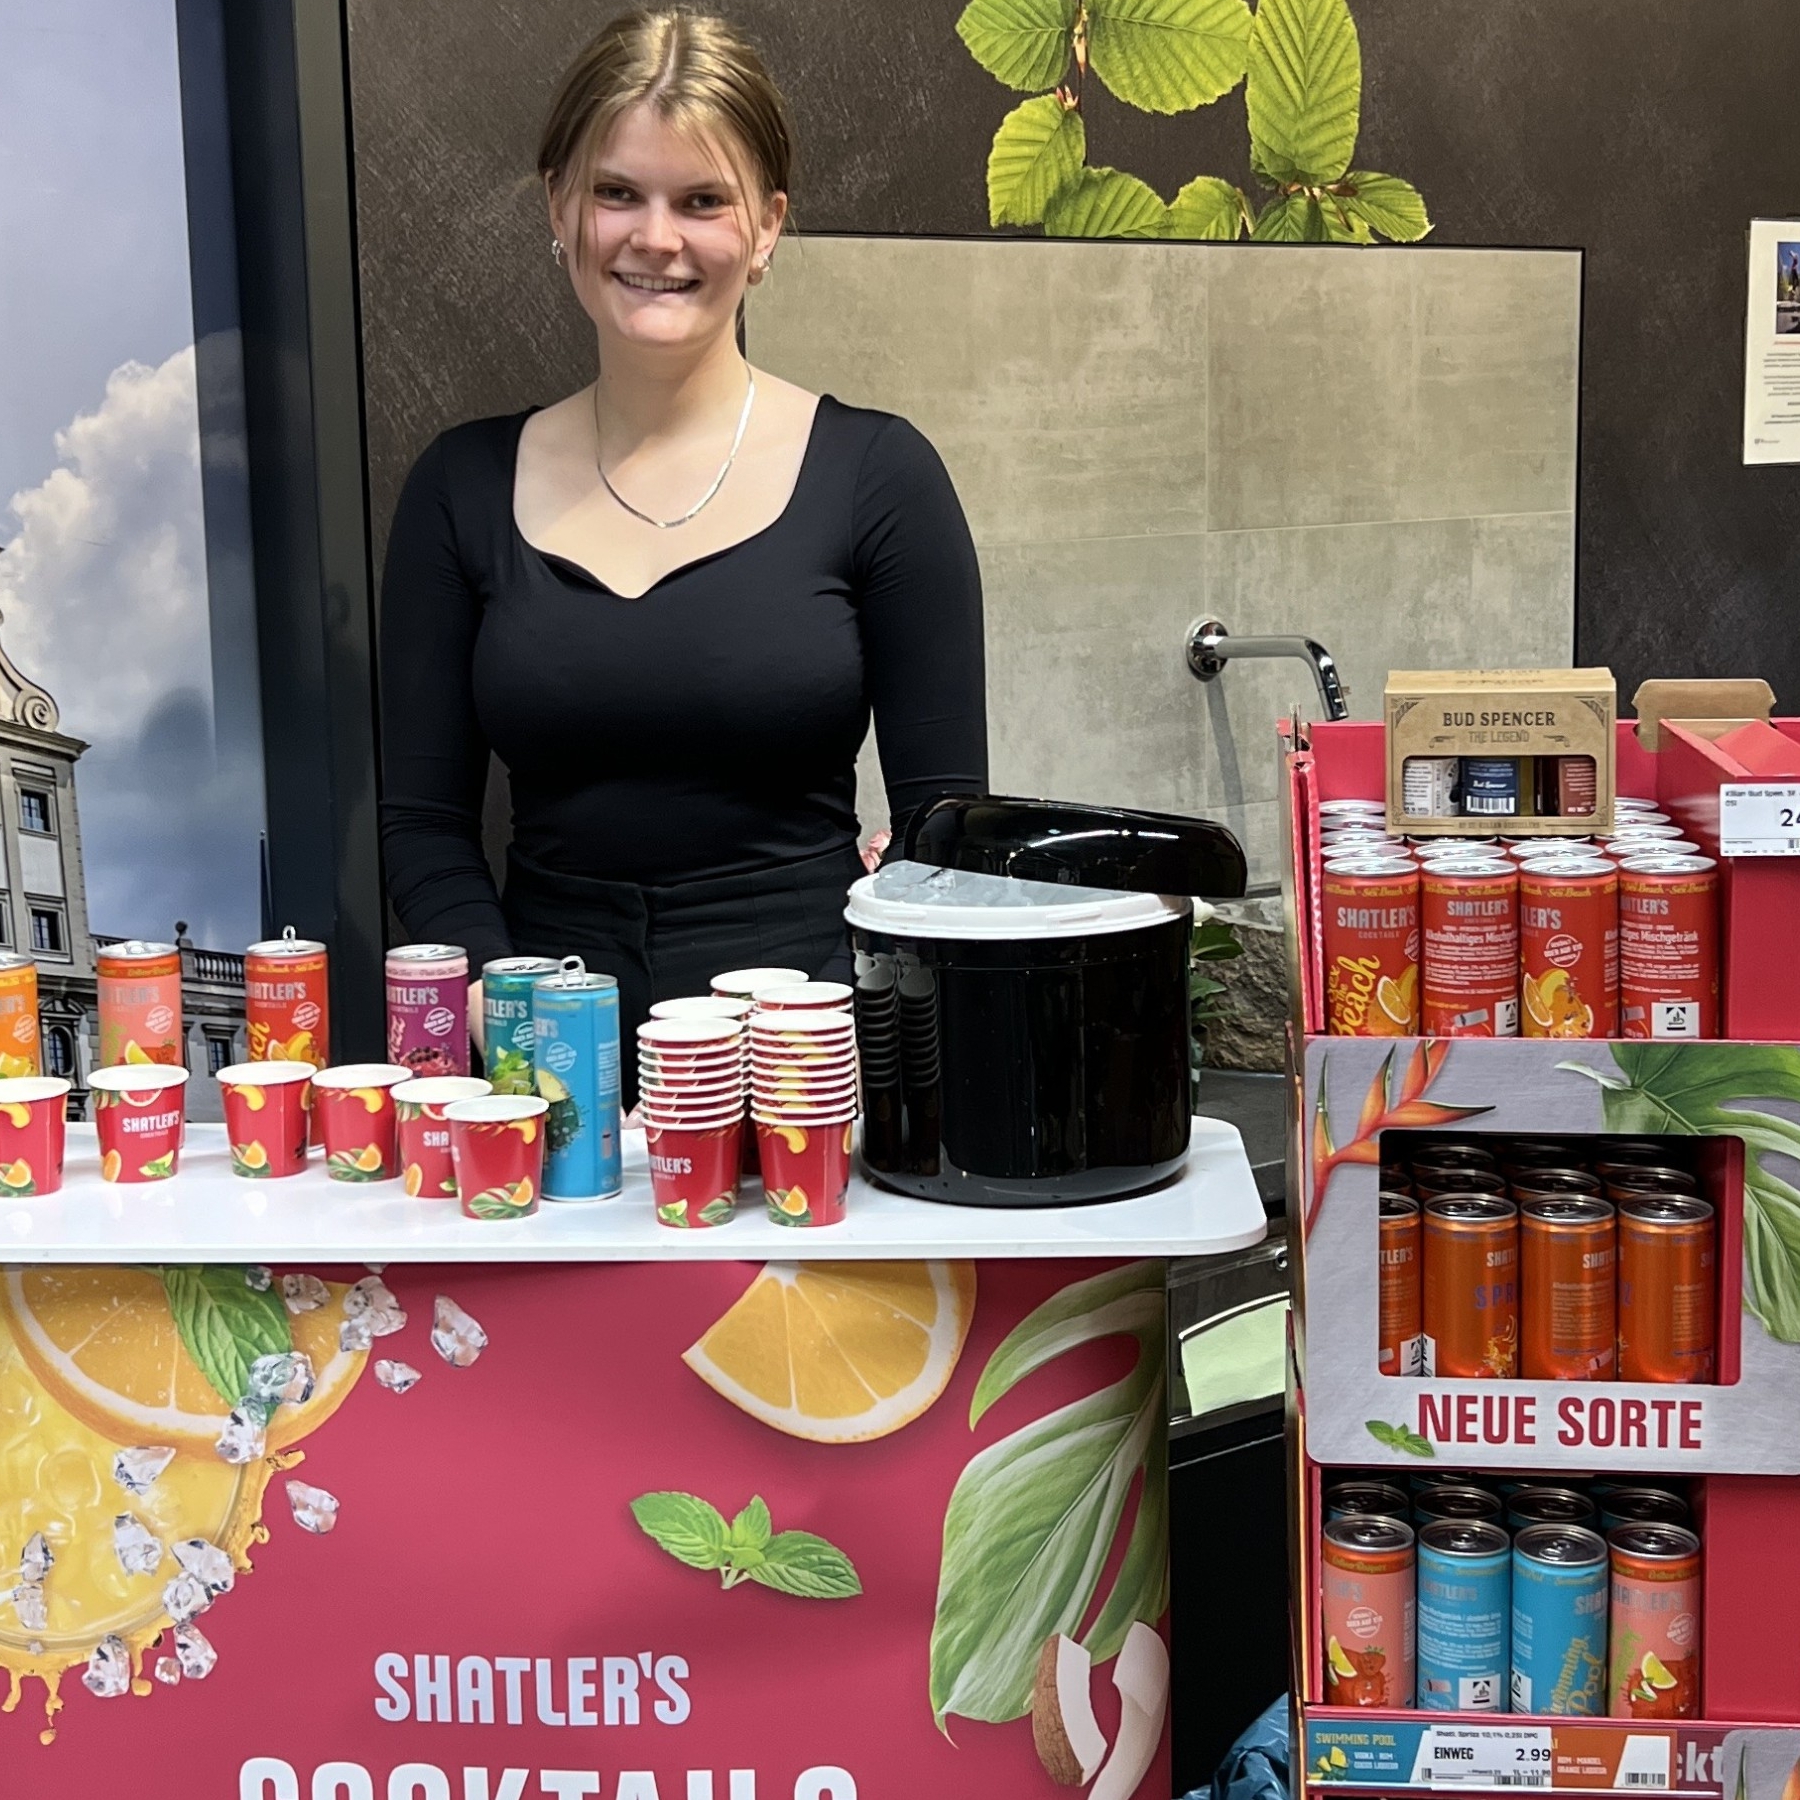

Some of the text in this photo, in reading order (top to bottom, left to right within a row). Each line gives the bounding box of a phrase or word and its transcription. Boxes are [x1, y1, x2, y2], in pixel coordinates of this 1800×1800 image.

[1442, 711, 1556, 727] BUD SPENCER
[1468, 729, 1530, 744] THE LEGEND
[1780, 808, 1800, 827] 2
[1447, 899, 1509, 916] SHATLER'S
[1338, 906, 1416, 929] SHATLER'S
[122, 1110, 180, 1133] SHATLER'S
[423, 1131, 449, 1147] SHA
[1475, 1282, 1516, 1309] SPR
[1418, 1393, 1703, 1449] NEUE SORTE
[374, 1651, 691, 1727] SHATLER'S
[1315, 1732, 1396, 1746] SWIMMING POOL
[1434, 1747, 1551, 1761] EINWEG 2.99
